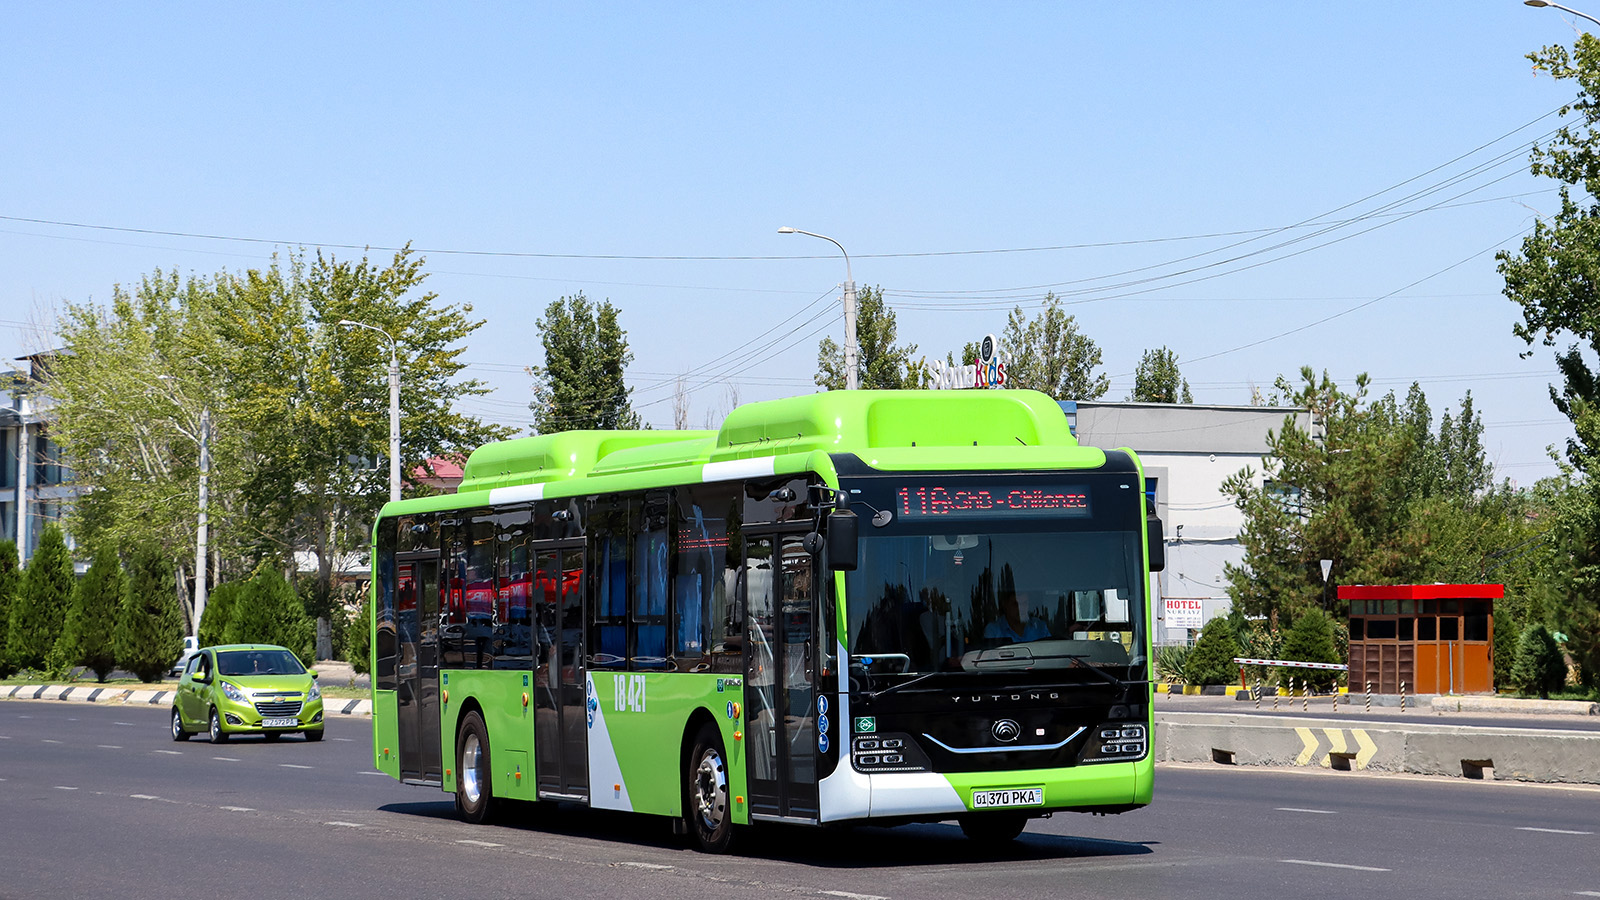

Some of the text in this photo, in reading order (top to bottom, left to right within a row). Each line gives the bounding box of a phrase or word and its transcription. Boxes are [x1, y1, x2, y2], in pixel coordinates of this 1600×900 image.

[899, 487, 949, 515] 116
[1166, 600, 1201, 609] HOTEL
[613, 674, 646, 712] 18 421
[951, 692, 1059, 703] YUTONG
[976, 790, 1036, 805] 01 370 PKA
